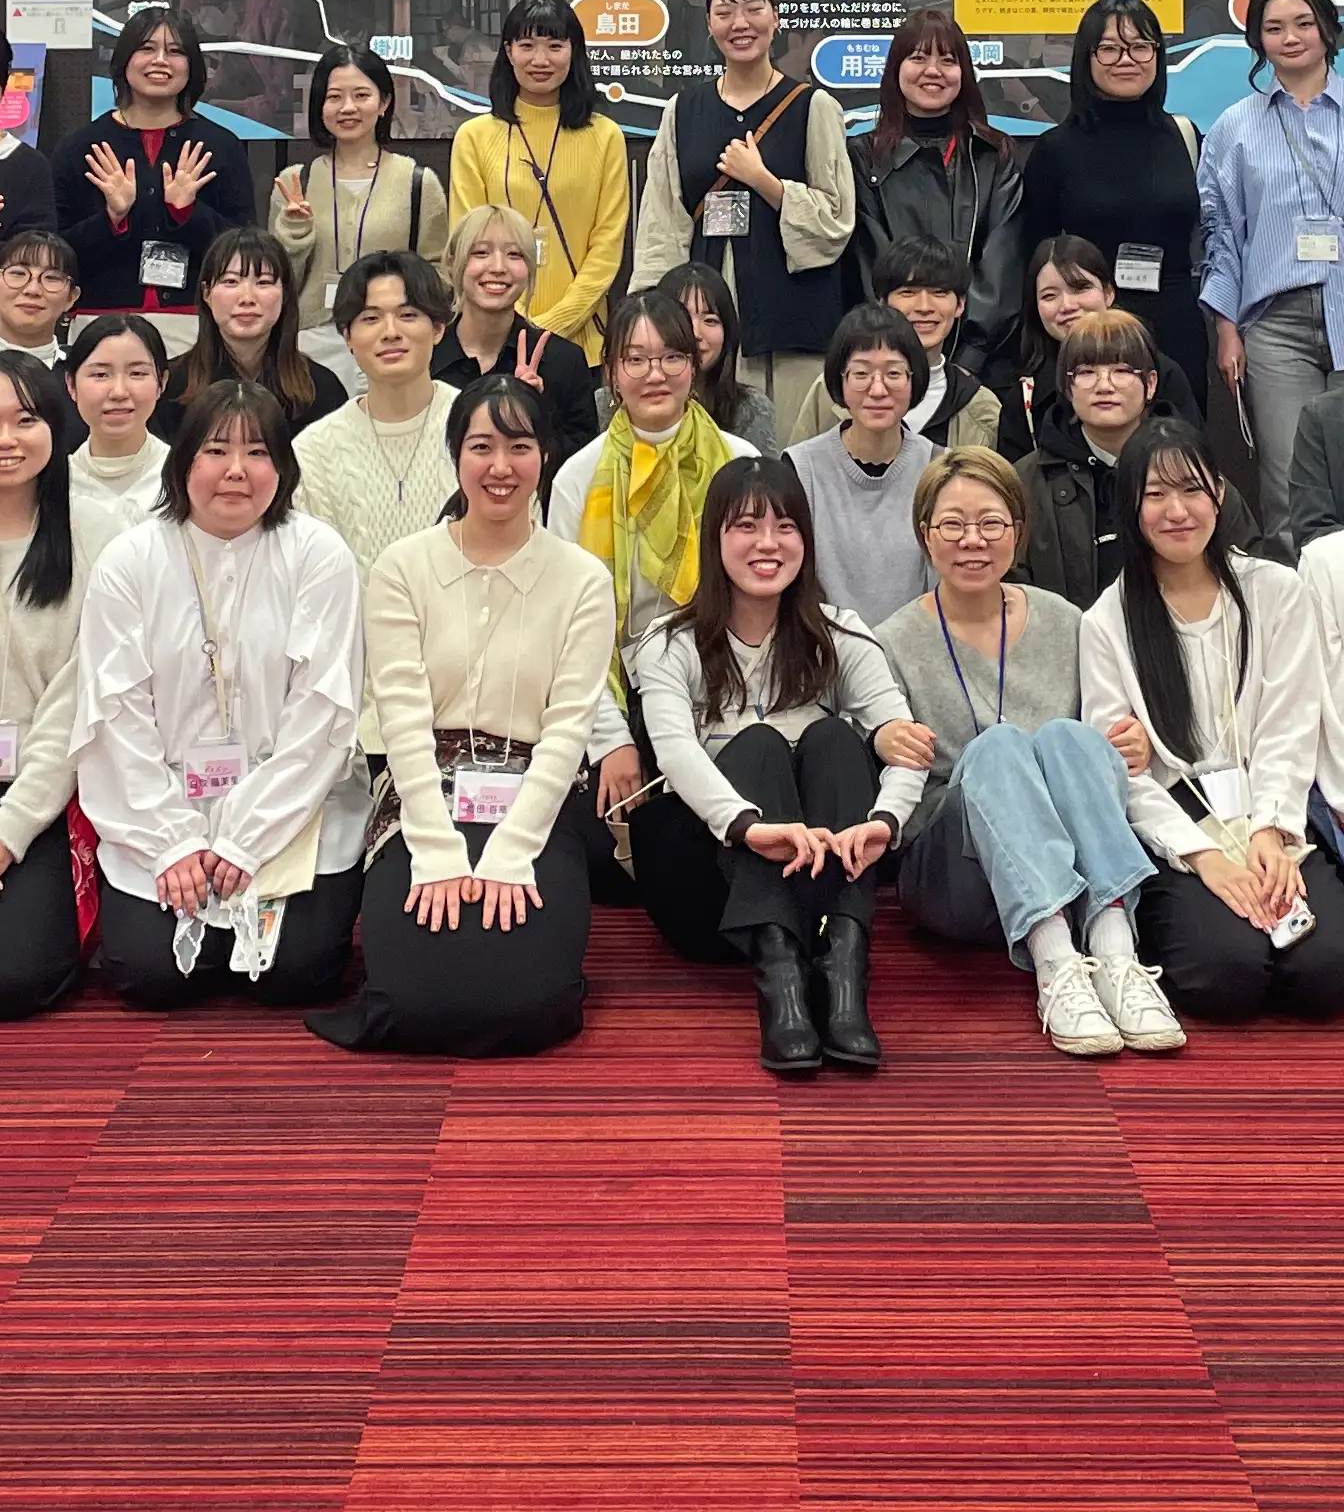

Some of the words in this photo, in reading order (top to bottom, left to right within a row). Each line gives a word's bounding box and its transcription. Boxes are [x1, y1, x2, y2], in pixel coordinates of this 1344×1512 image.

[605, 1, 630, 11] しまだ
[595, 13, 640, 35] 島田
[779, 18, 907, 29] 気づけば人の輪に巻き込ま
[587, 49, 683, 61] だ人、継がれたもの
[840, 55, 886, 78] 用宗
